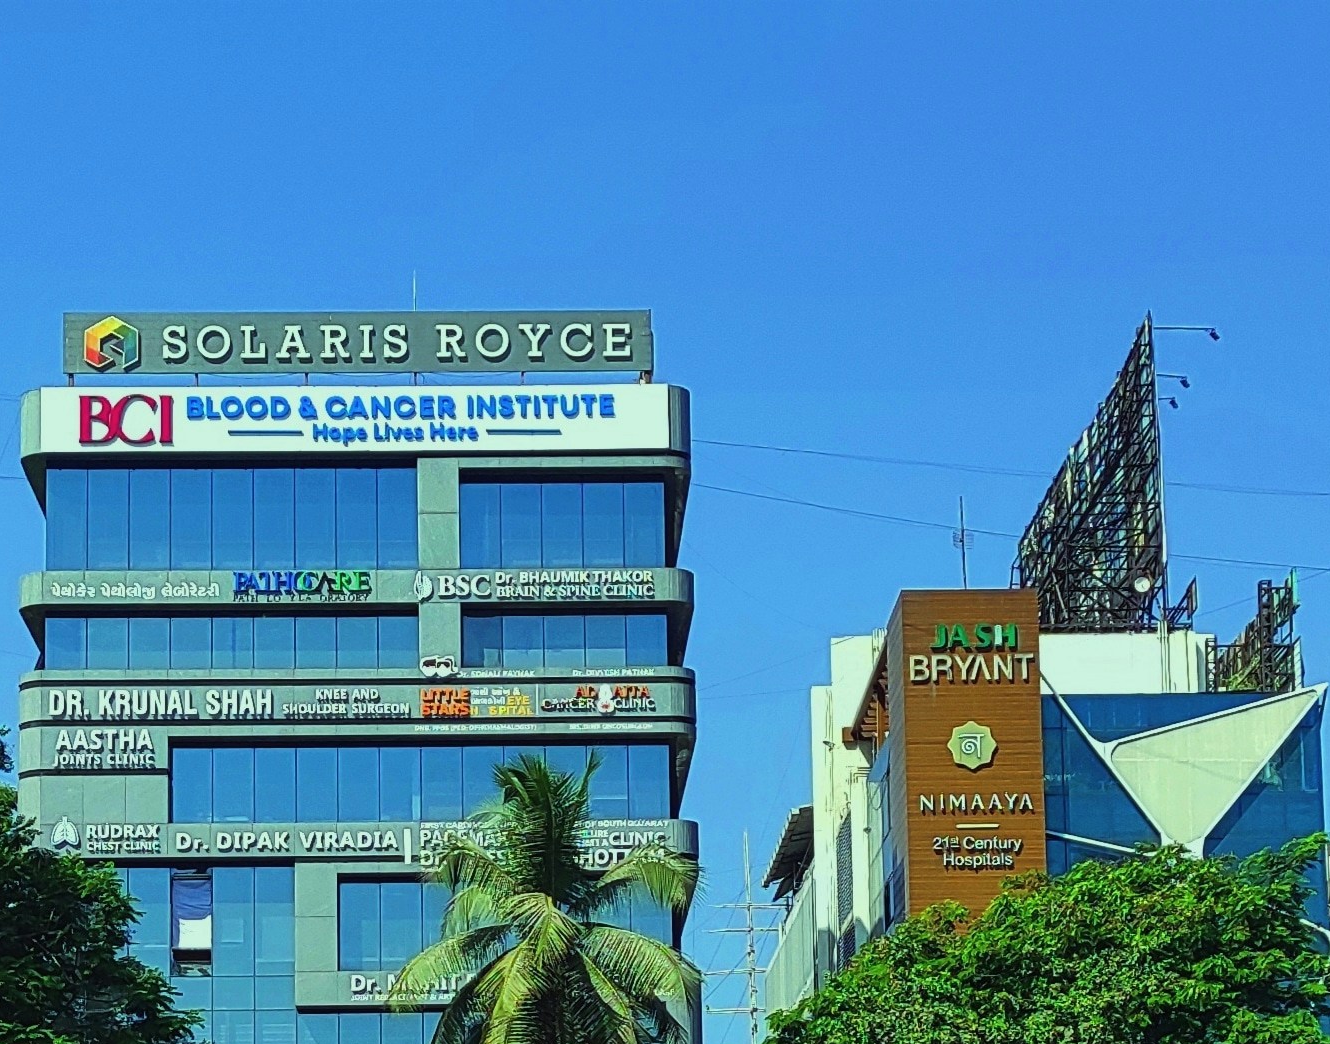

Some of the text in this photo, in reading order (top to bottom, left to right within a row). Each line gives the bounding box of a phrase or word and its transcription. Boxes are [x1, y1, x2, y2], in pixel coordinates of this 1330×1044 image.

[161, 321, 634, 361] SOLARIS ROYCE
[186, 393, 616, 421] BLOOD & CANCER INSTITUTE
[78, 394, 175, 446] BCI
[312, 422, 479, 446] Hope Lives Here
[495, 570, 654, 584] Dr. BHAUMIK THAKOR
[437, 575, 492, 597] BSC
[495, 584, 656, 598] BRAIN & SPINE CLINIC
[931, 623, 1019, 650] JASH
[909, 652, 1035, 683] BRYANT
[48, 688, 272, 717] DR. KRUNAL SHAH
[315, 688, 380, 700] KNEE AND
[420, 687, 471, 702] LITTLE
[506, 695, 531, 706] EYE
[282, 702, 410, 715] SHOULDER SURGEON
[420, 702, 471, 717] STARS
[614, 697, 656, 709] CLINIC
[55, 729, 154, 751] AASTHA
[53, 753, 156, 767] JOINTS CLINIC
[918, 792, 1035, 812] NIMAAYA
[86, 824, 161, 840] RUDRAX
[175, 830, 399, 851] Dr. DIPAK VIRADIA
[86, 840, 162, 852] CHEST CLINIC
[932, 834, 1022, 851] 21st Century
[942, 852, 1014, 868] Hospitals
[349, 974, 382, 992] Dr.
